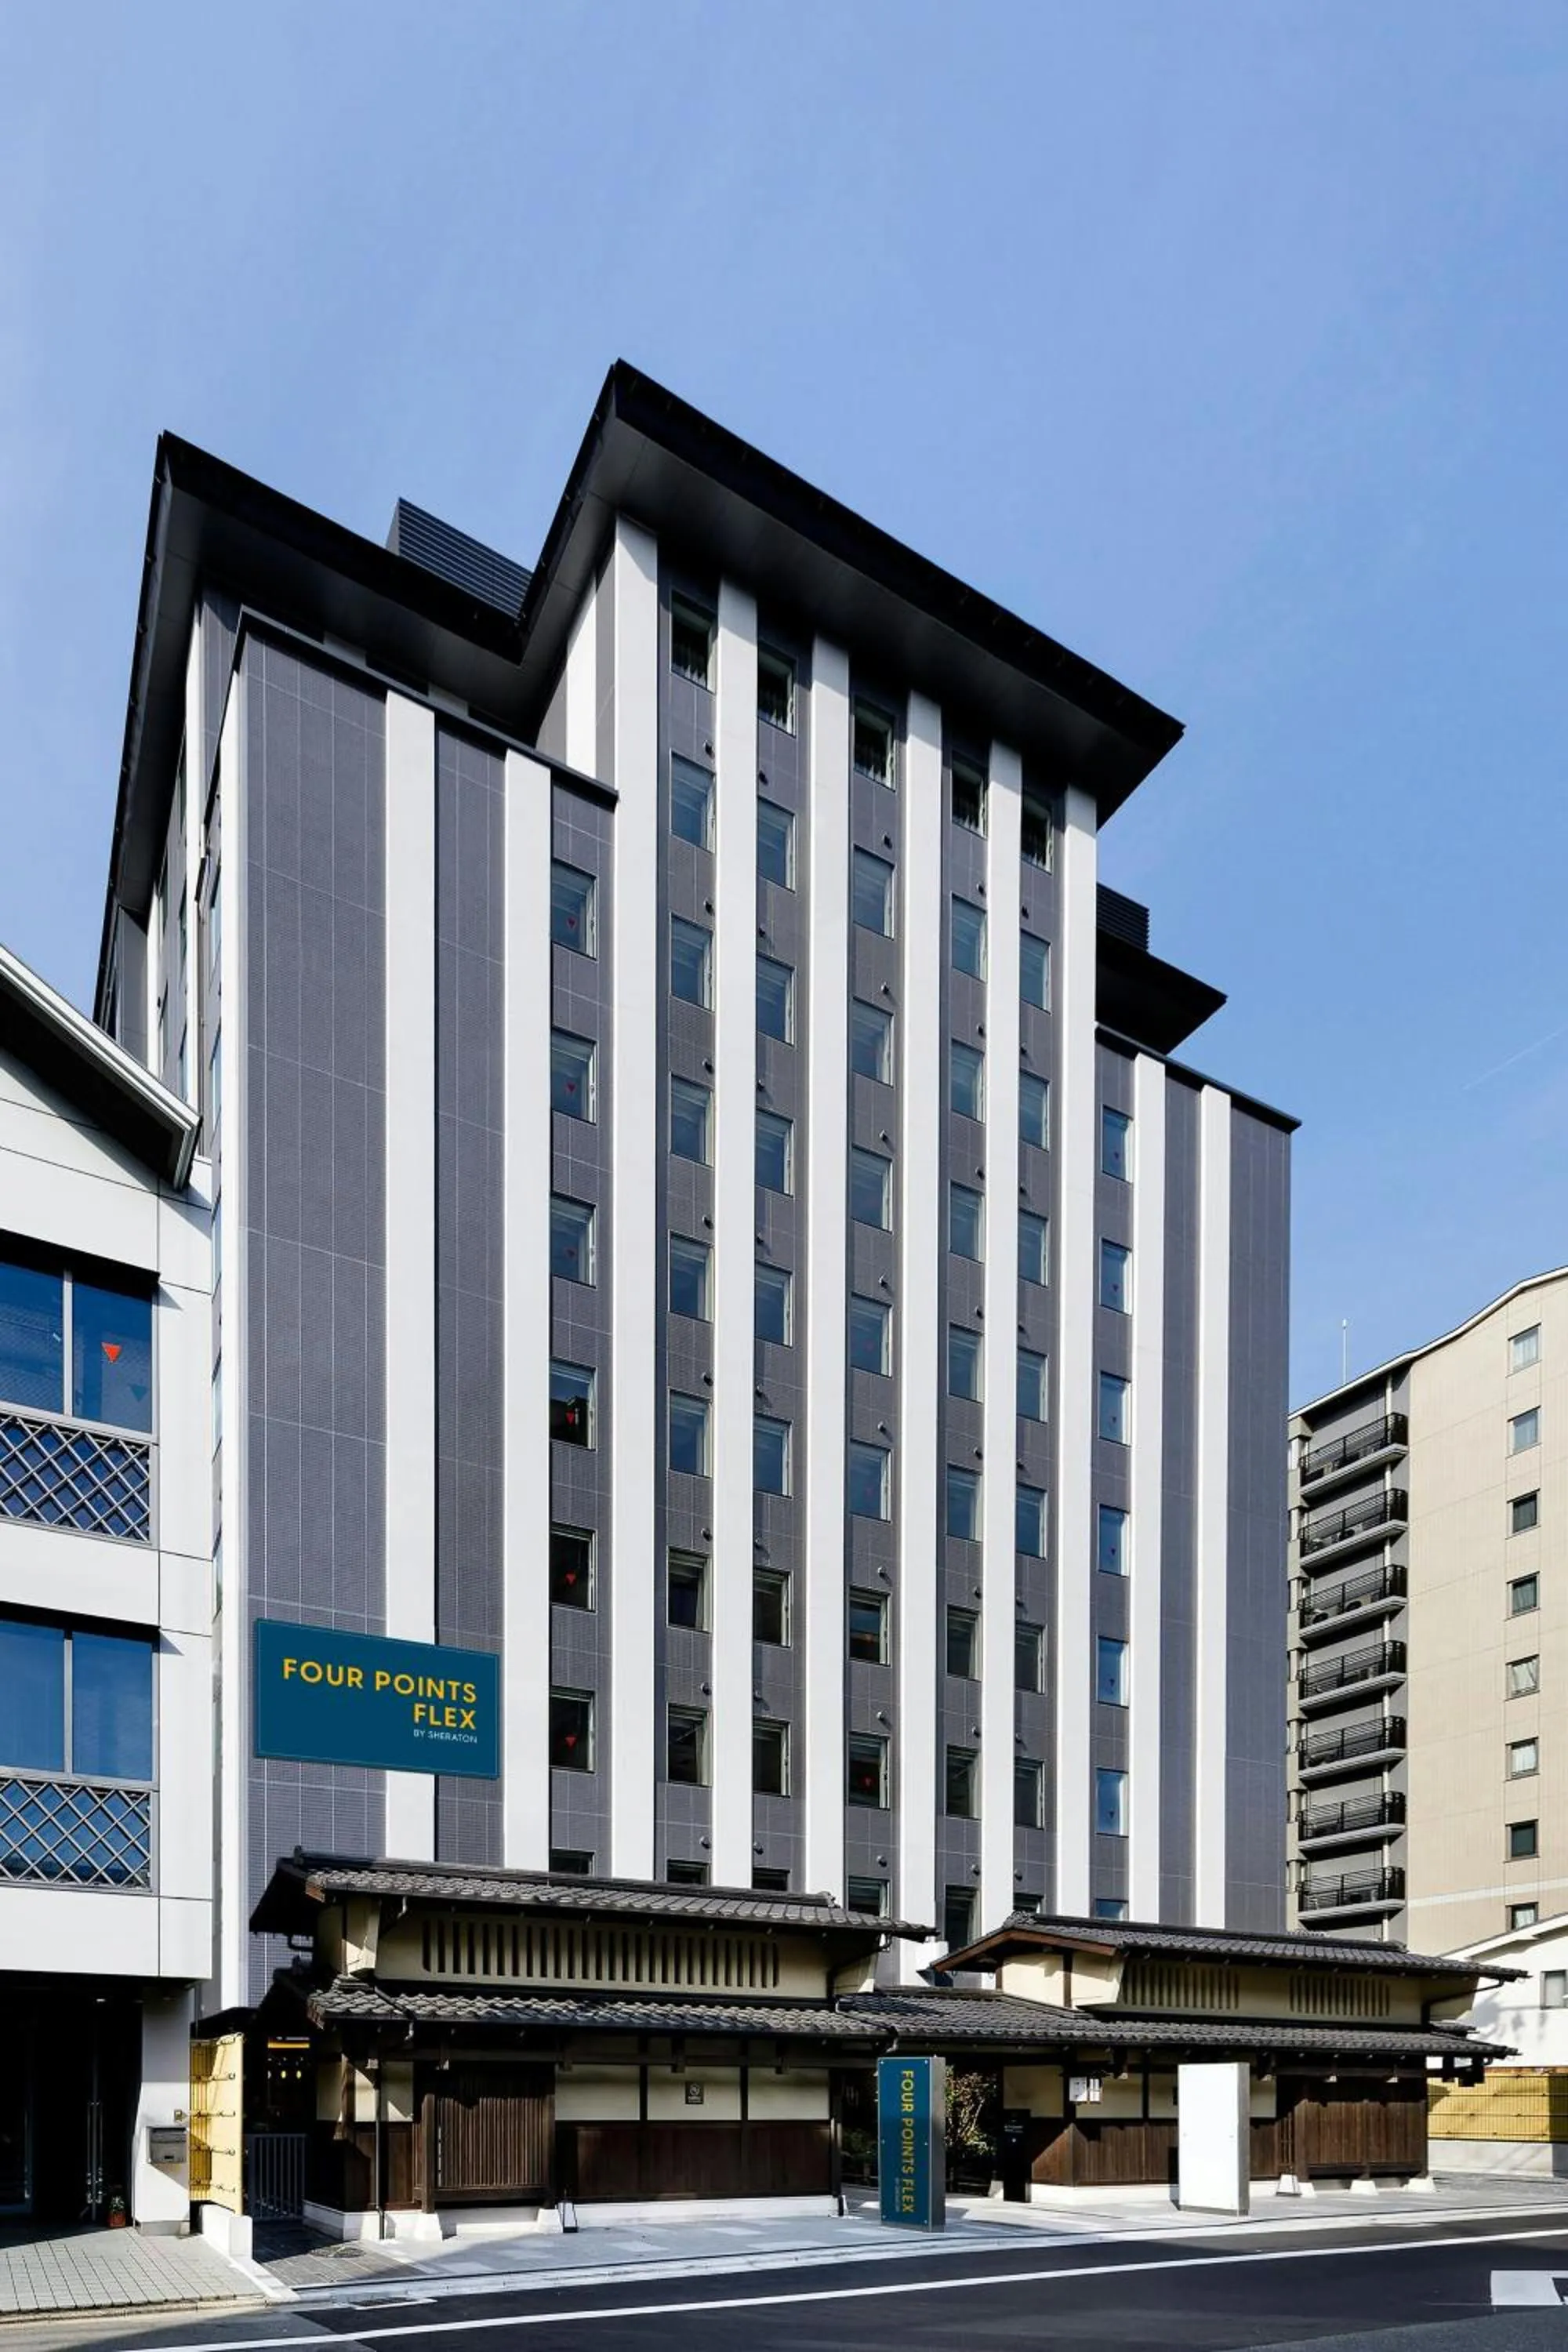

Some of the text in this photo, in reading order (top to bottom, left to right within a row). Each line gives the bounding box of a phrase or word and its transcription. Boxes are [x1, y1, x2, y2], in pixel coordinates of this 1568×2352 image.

[282, 1658, 477, 1703] FOUR POINTS
[413, 1703, 477, 1730] FLEX
[413, 1729, 478, 1744] BY SHERATON
[902, 2070, 915, 2212] FOUR POINTS FLEX
